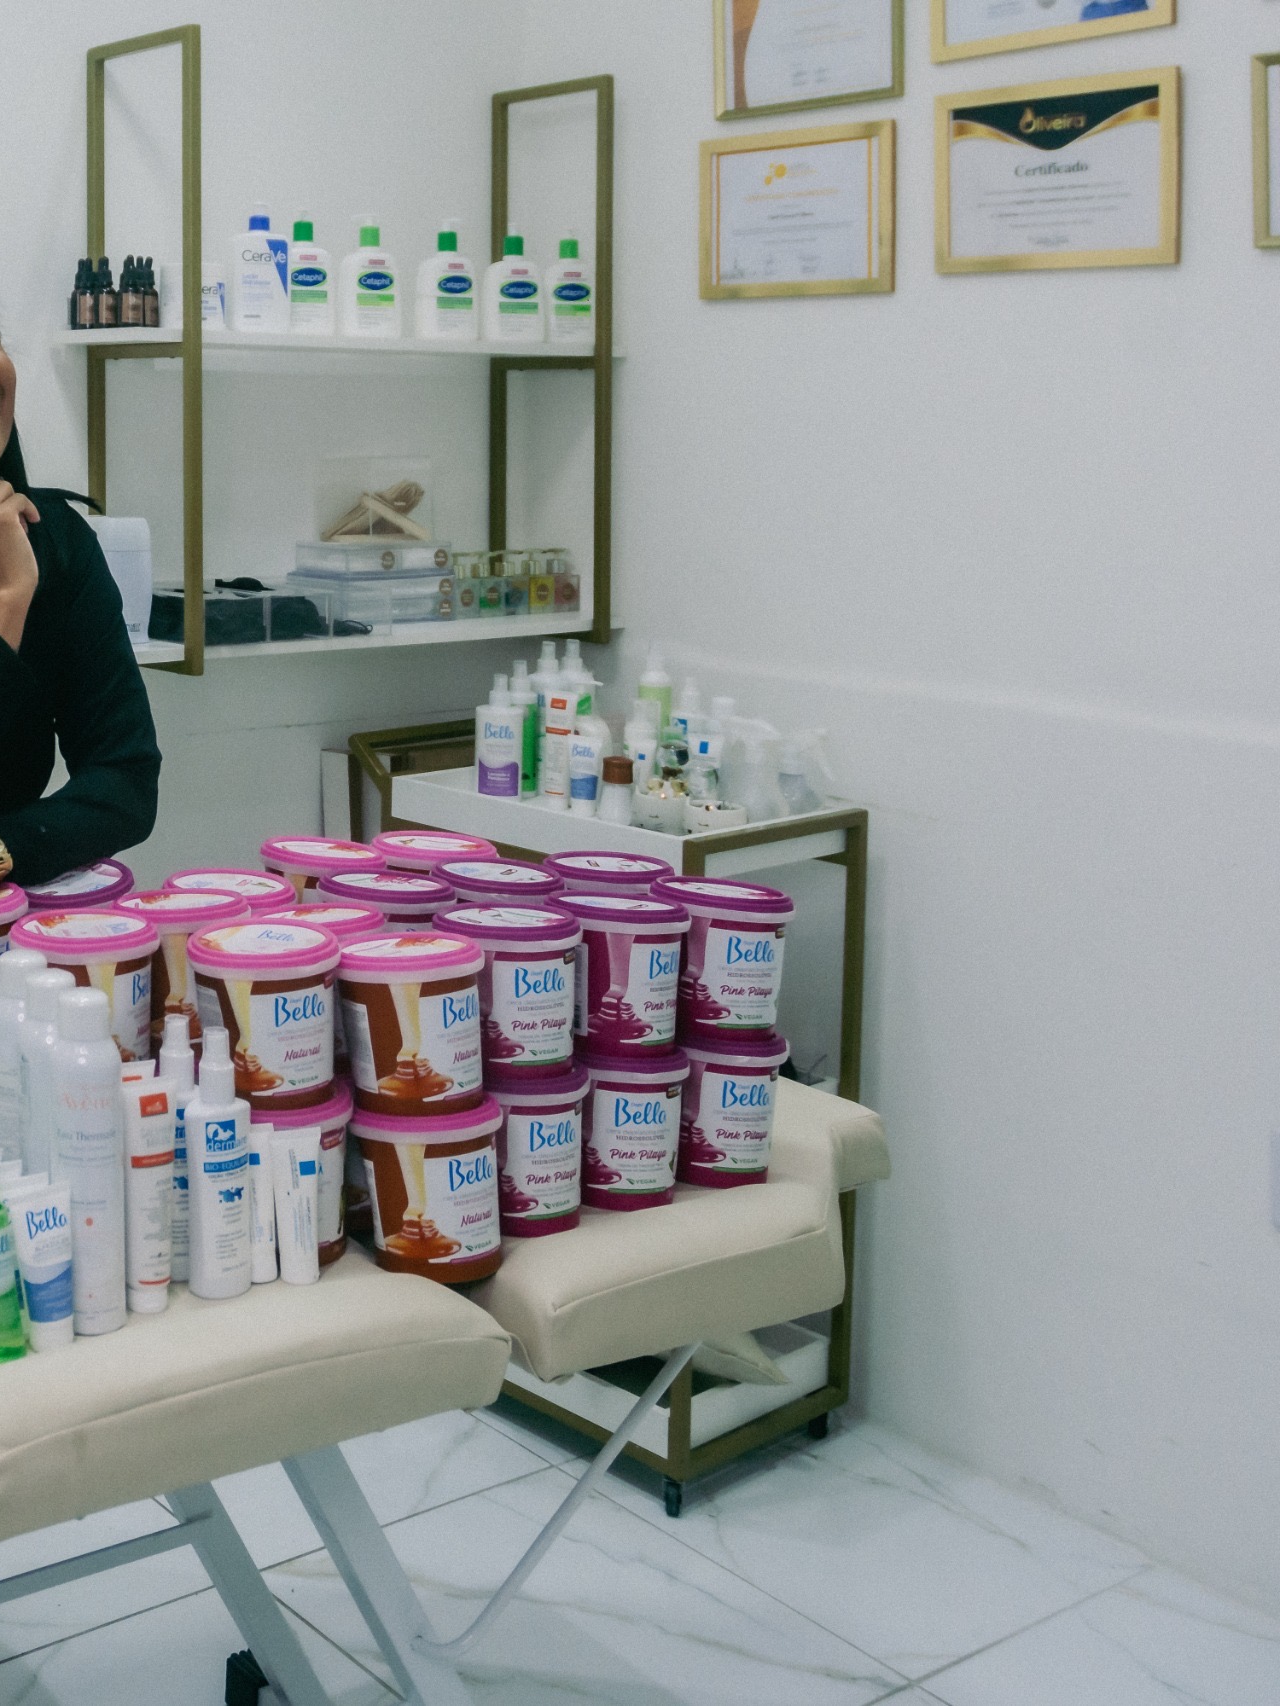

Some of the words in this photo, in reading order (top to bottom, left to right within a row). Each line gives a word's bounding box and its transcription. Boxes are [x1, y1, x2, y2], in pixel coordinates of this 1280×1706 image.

[1014, 160, 1089, 177] Certificado
[241, 249, 287, 263] CeraVe
[484, 722, 515, 740] Bella
[726, 936, 775, 965] Bella
[649, 949, 678, 979] Bell
[515, 967, 566, 998] Bella
[720, 984, 746, 996] Pink
[274, 993, 325, 1027] Bella
[644, 1001, 665, 1012] Pink
[511, 1020, 538, 1031] Pink
[284, 1043, 321, 1062] Natural
[721, 1080, 770, 1109] Bella
[614, 1097, 667, 1127] Bella
[529, 1120, 576, 1152] Bella
[715, 1128, 741, 1139] Pink
[609, 1148, 636, 1160] Pink
[448, 1155, 493, 1192] Bella
[525, 1173, 551, 1186] Pink
[25, 1206, 68, 1240] Bella
[461, 1208, 492, 1227] Natural
